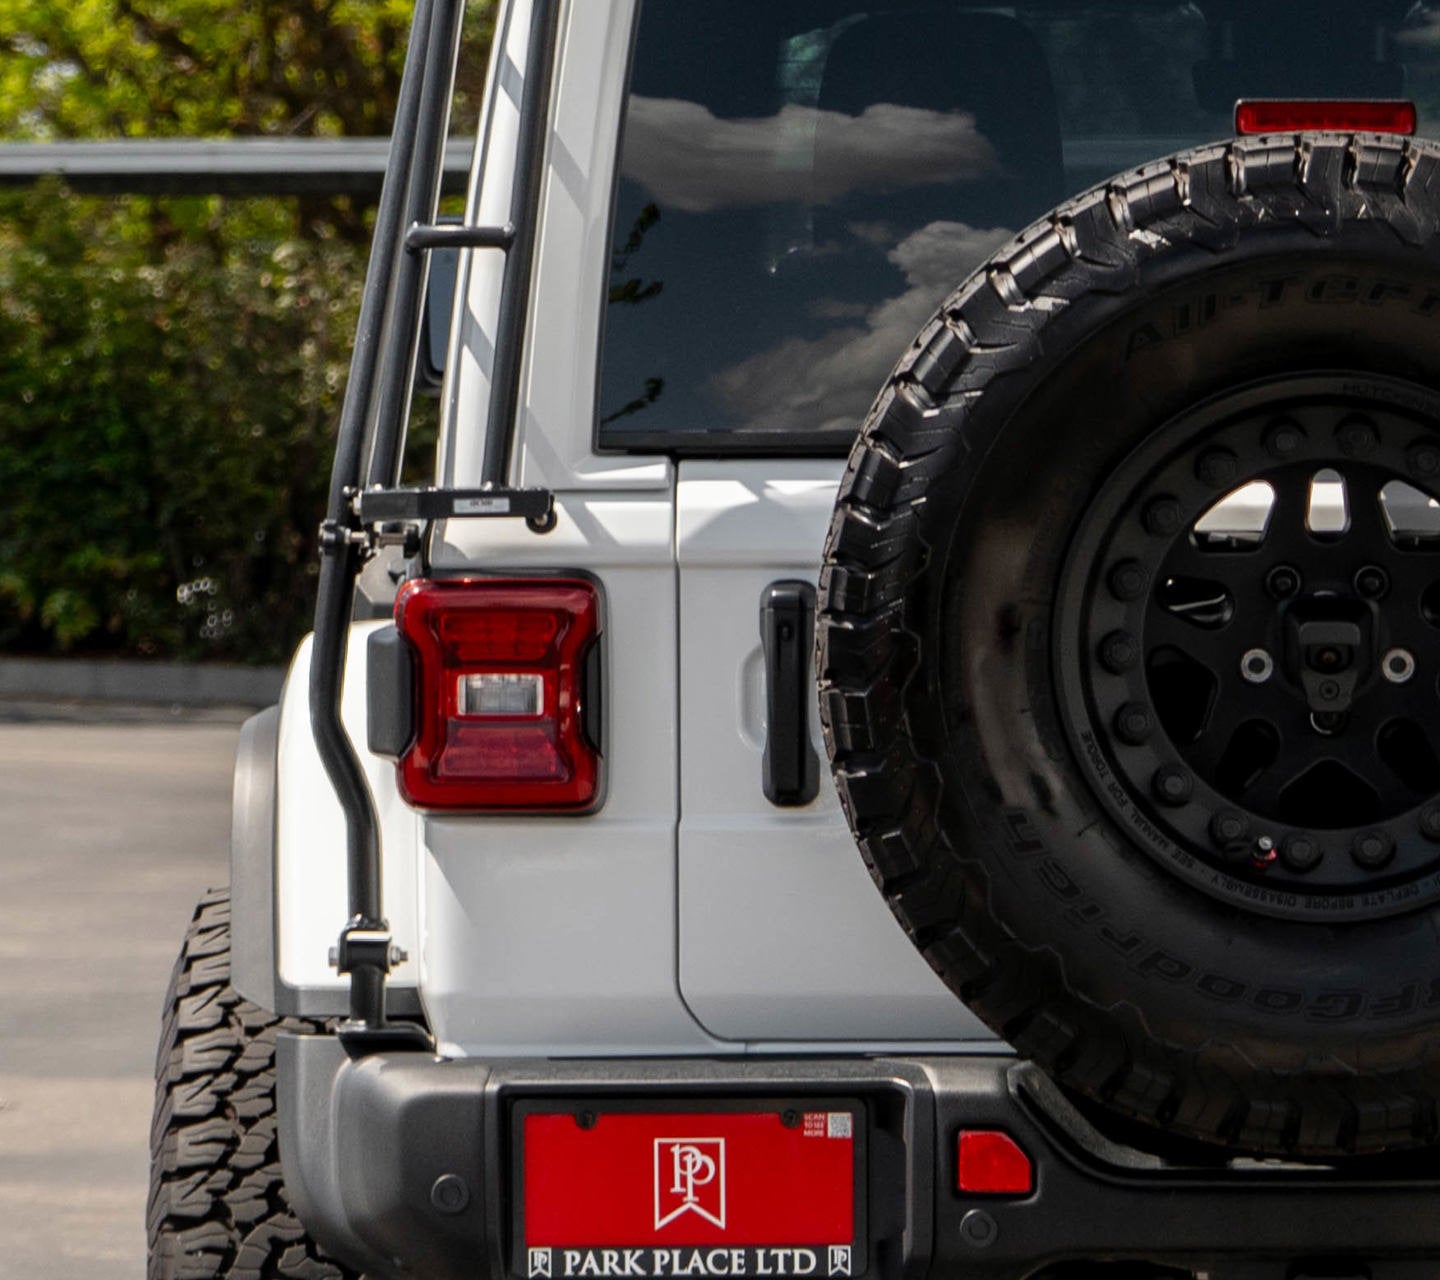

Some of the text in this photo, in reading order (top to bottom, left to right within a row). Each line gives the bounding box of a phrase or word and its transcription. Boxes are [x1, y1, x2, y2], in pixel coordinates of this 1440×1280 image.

[563, 1249, 647, 1276] PARK
[652, 1248, 746, 1276] PLACE
[755, 1247, 817, 1275] LTD
